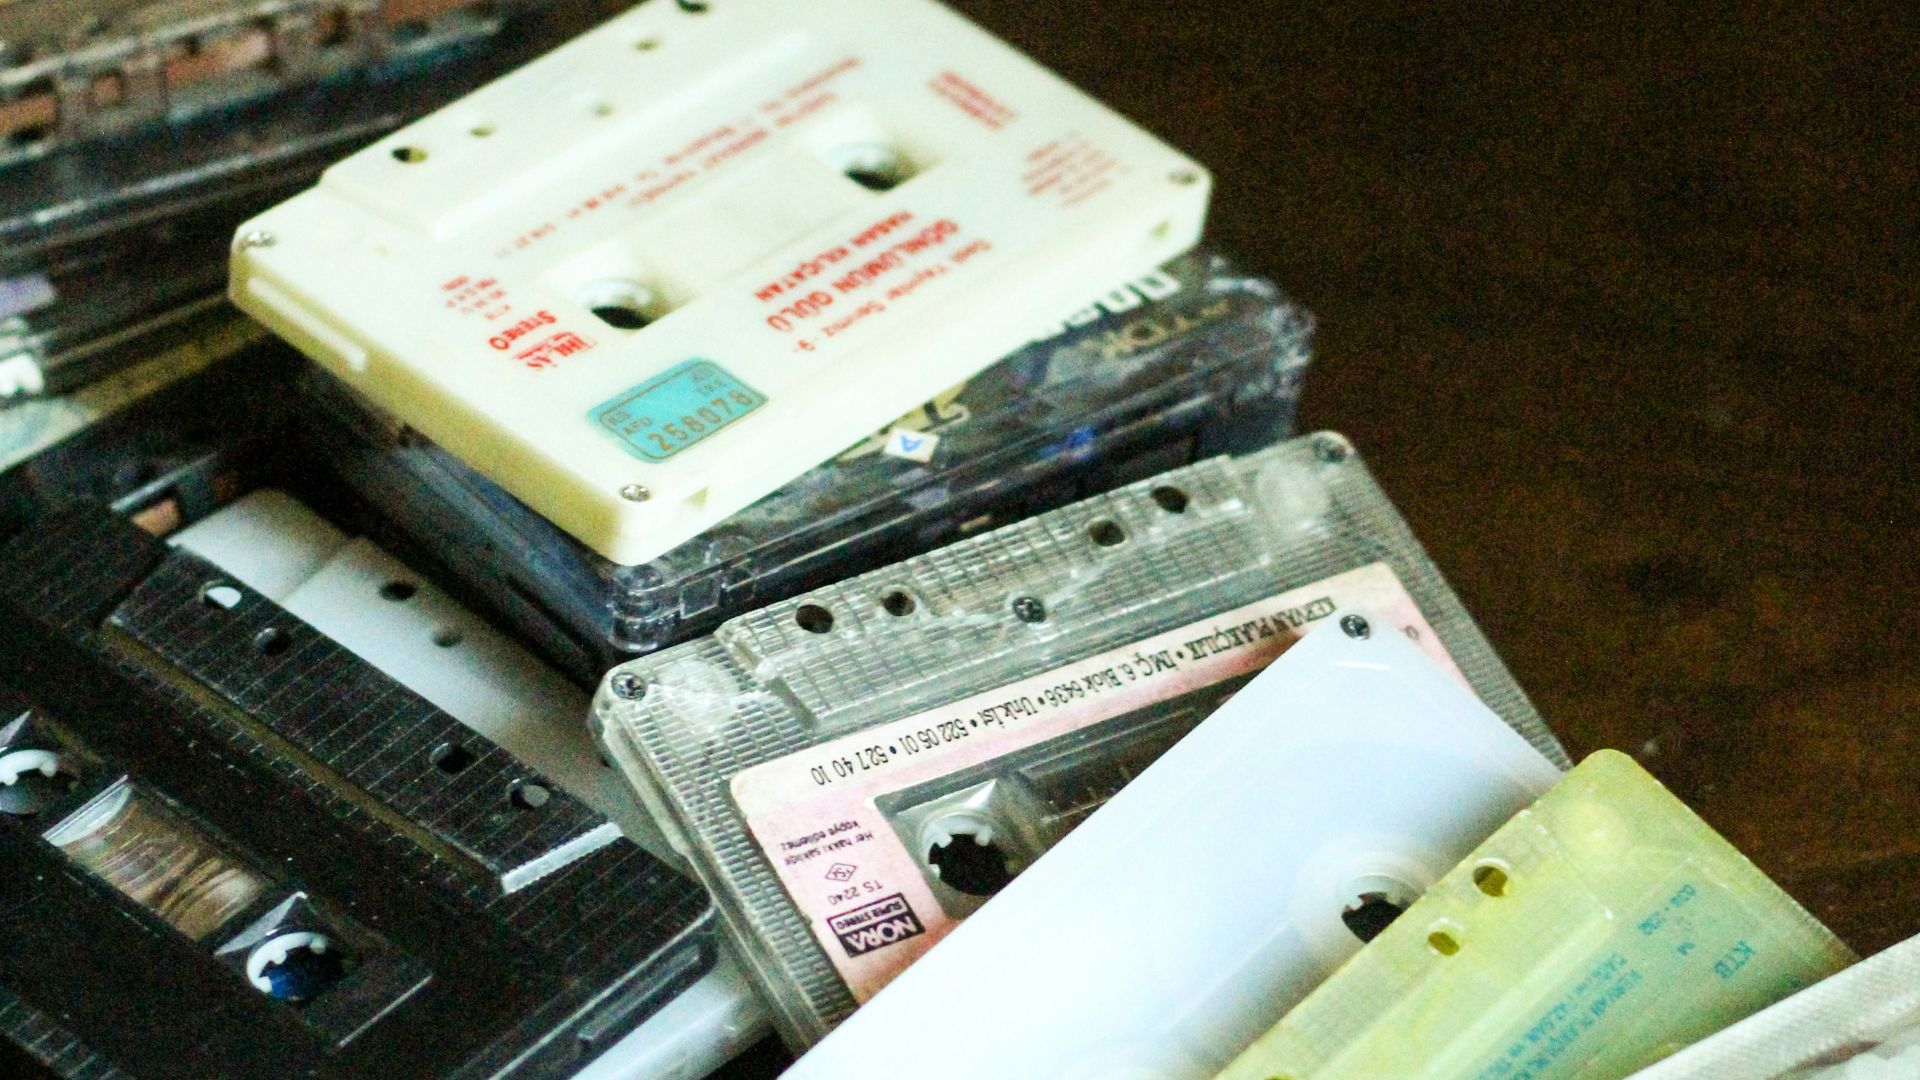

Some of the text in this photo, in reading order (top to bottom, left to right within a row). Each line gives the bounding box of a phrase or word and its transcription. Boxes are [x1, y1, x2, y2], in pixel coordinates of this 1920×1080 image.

[851, 210, 914, 247] HASAN
[766, 291, 833, 332] GÜLÜ
[1084, 668, 1122, 693] Blok
[1044, 680, 1085, 707] 6436
[917, 728, 941, 750] 05
[938, 718, 970, 742] 522
[898, 734, 920, 756] 01
[832, 757, 855, 778] 40
[856, 745, 889, 771] 527
[810, 764, 832, 786] 10
[857, 832, 874, 842] Her
[827, 879, 883, 905] TS 2240
[836, 901, 902, 930] SUPER STEREO
[846, 915, 917, 949] NORA
